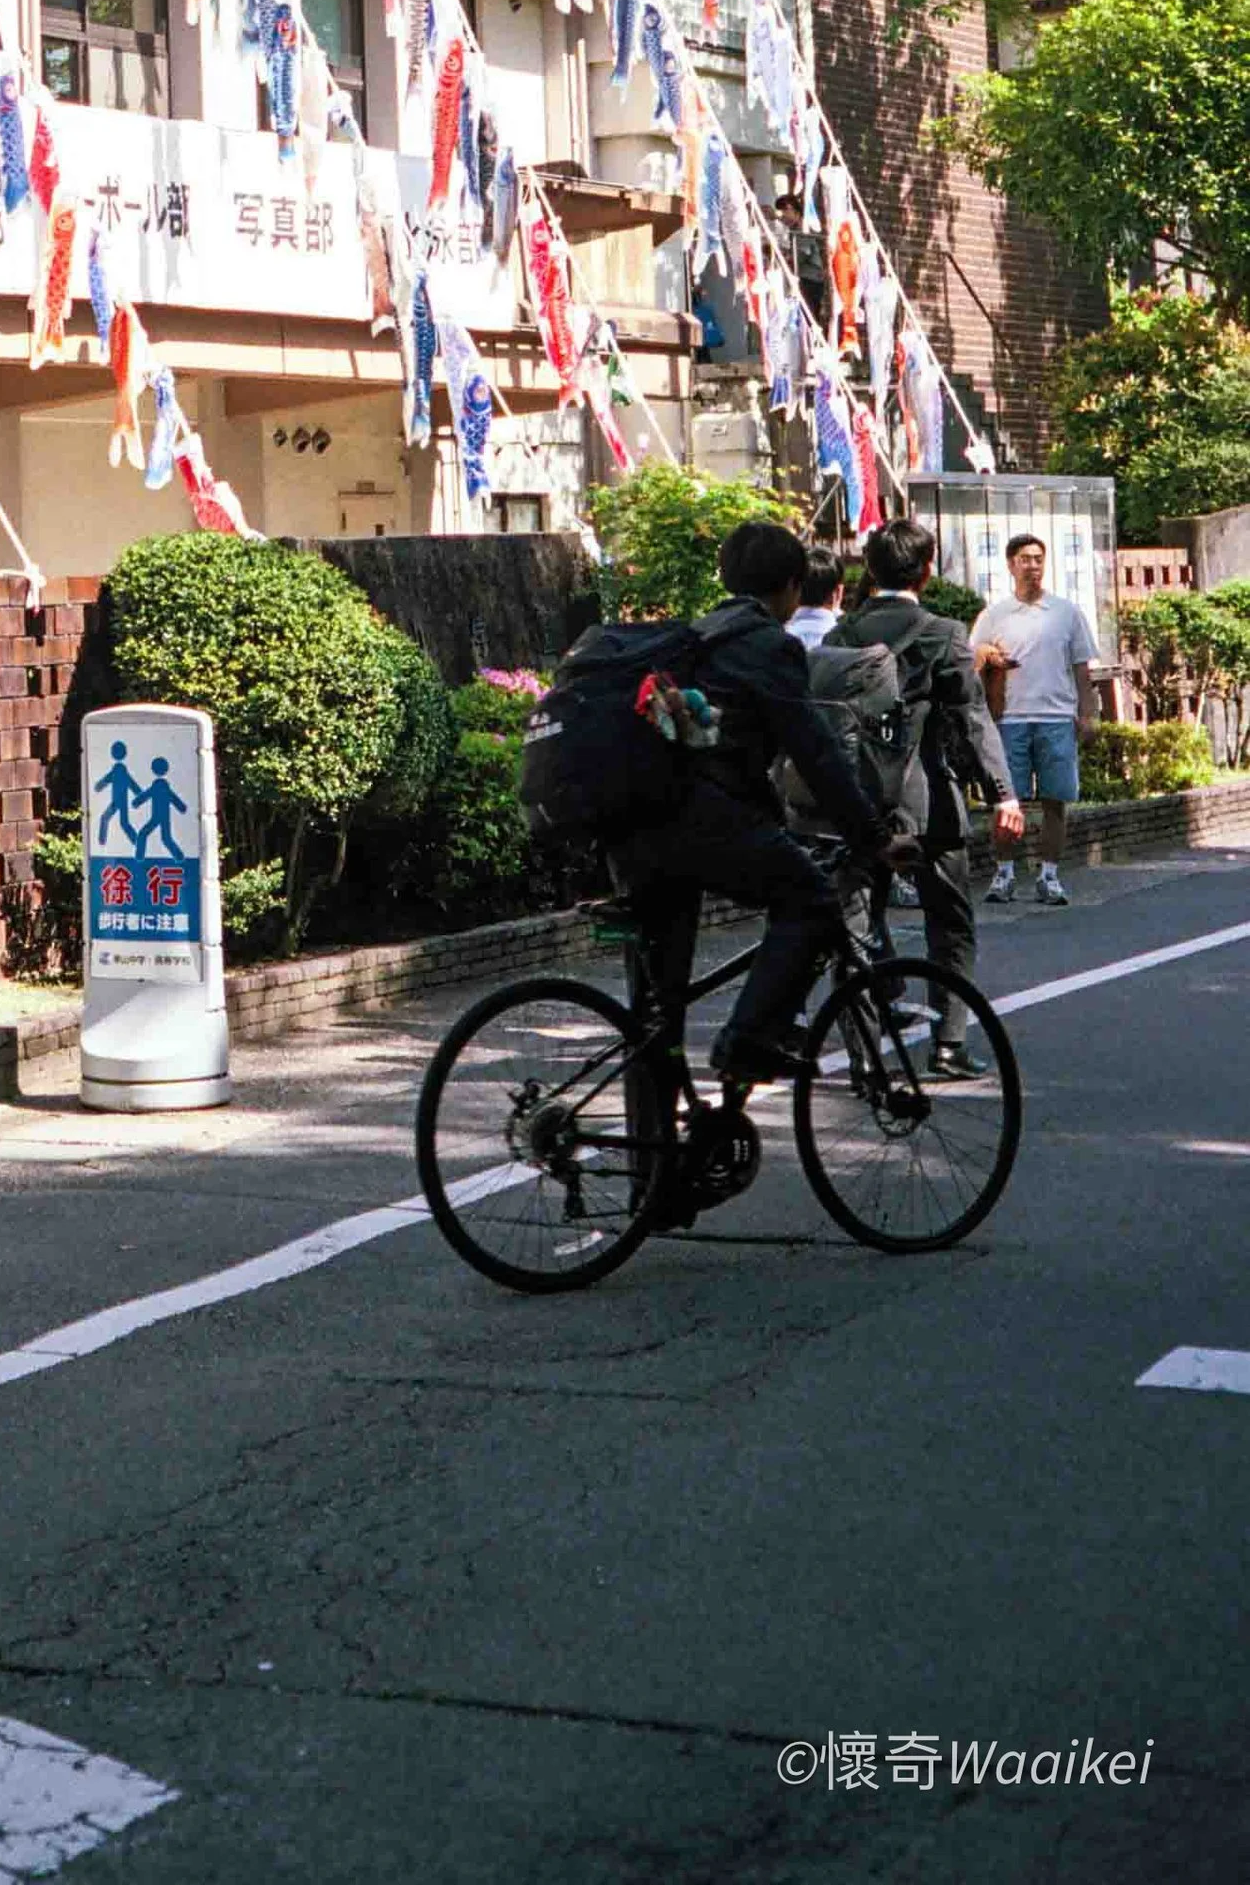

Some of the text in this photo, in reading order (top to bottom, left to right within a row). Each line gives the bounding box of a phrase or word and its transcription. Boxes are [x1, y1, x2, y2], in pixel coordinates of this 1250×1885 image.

[82, 174, 191, 239] ーボール部
[233, 191, 333, 256] 写真部
[100, 865, 184, 906] 徐行
[97, 910, 190, 933] 歩行者に注意
